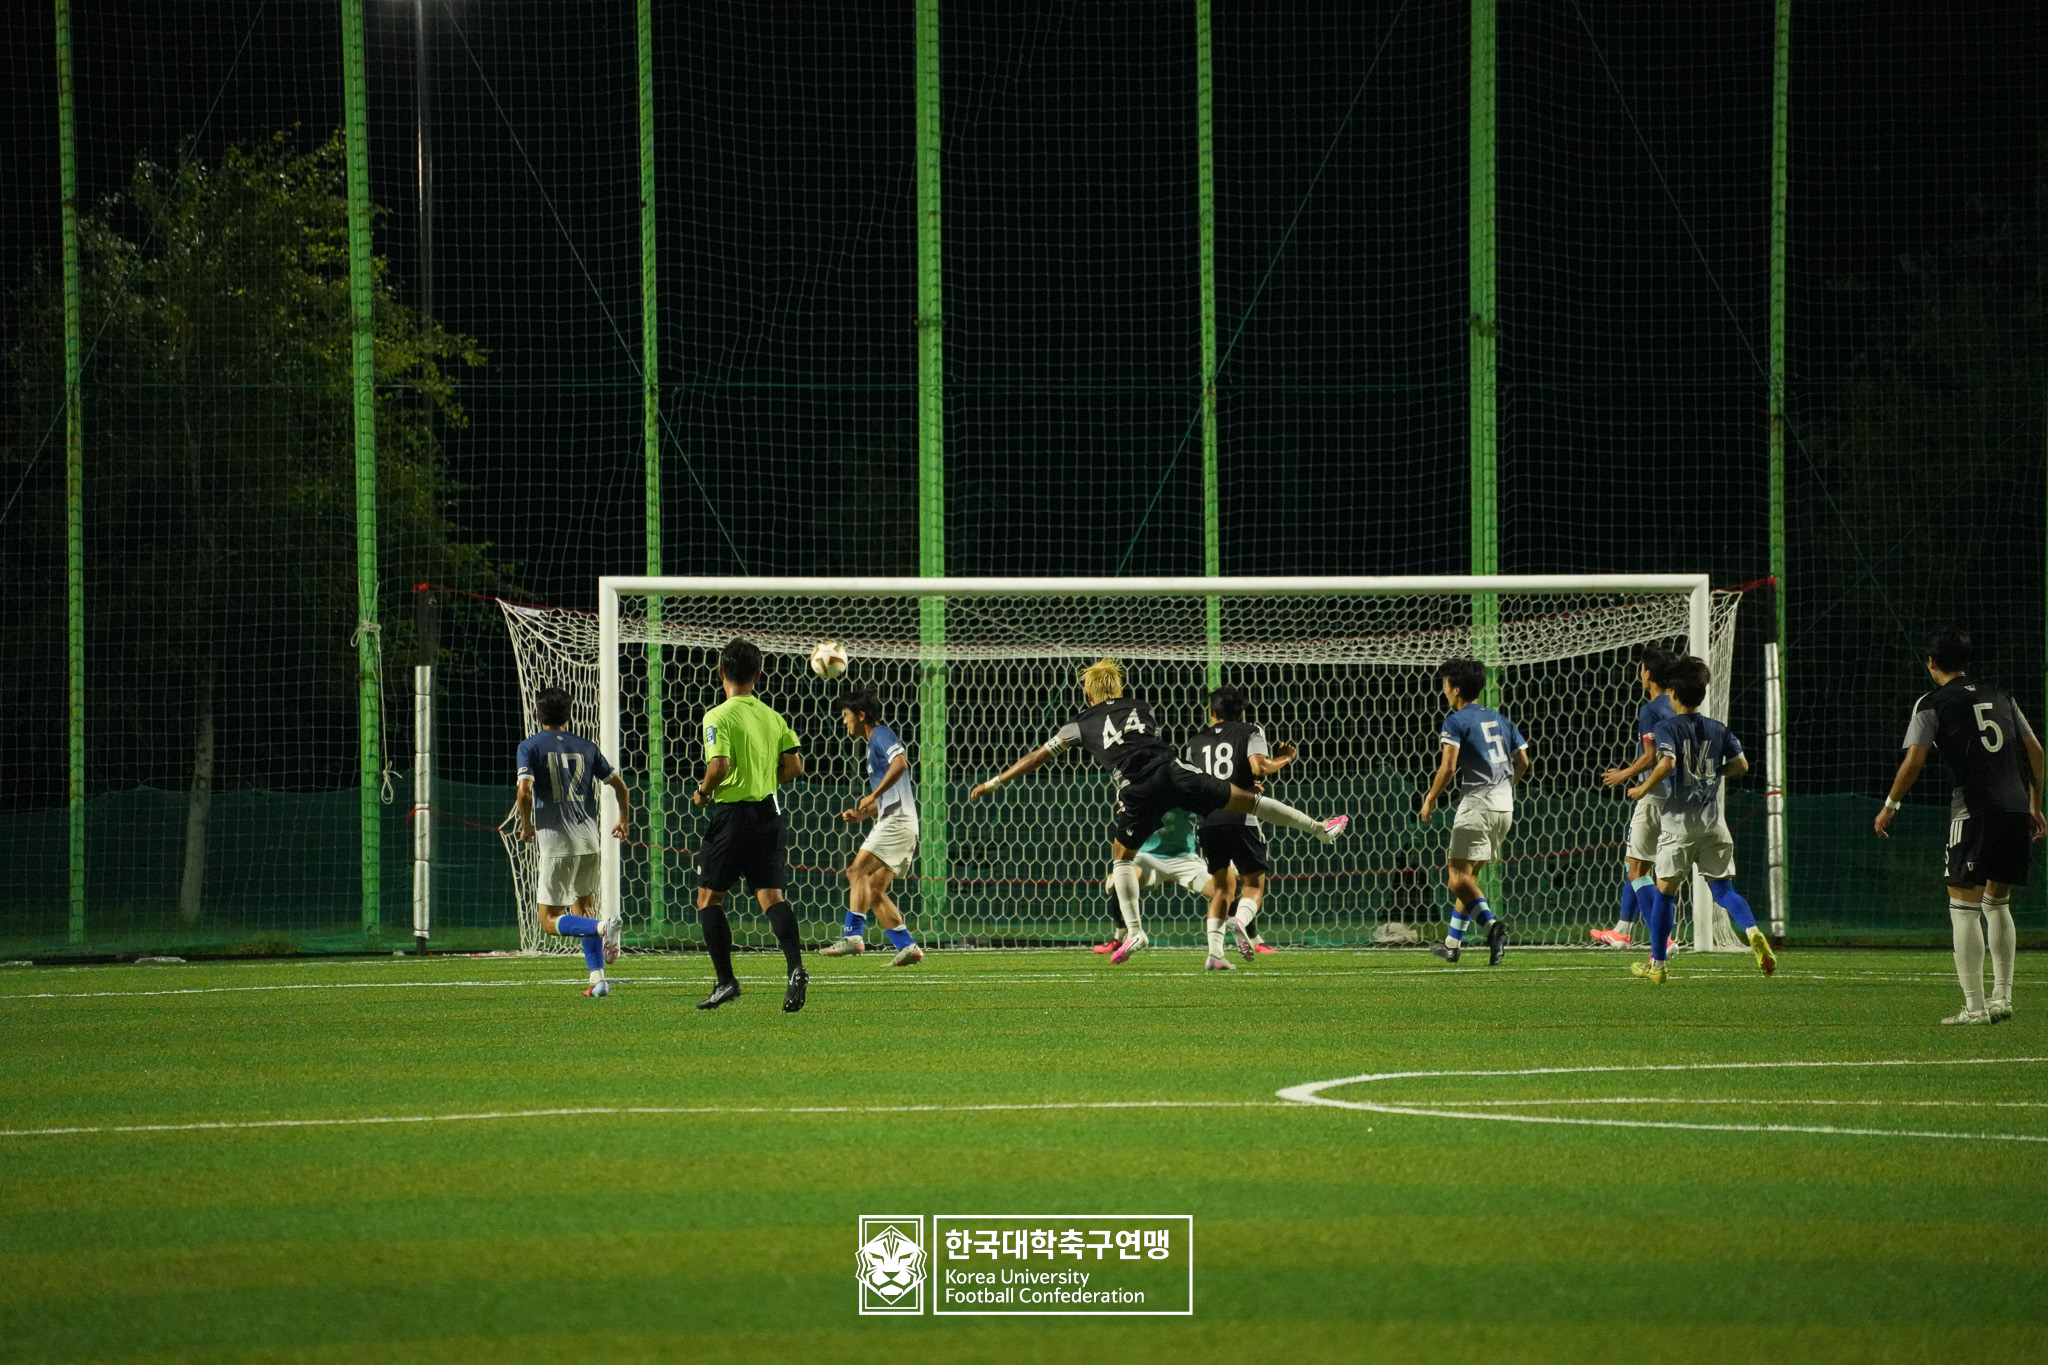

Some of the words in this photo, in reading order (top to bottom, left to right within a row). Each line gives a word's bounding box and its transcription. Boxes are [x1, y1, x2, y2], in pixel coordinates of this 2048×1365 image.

[1102, 708, 1146, 750] 44
[1480, 720, 1508, 764] 5
[1973, 703, 2004, 753] 5
[547, 752, 585, 803] 12
[1202, 742, 1234, 780] 18
[1682, 739, 1716, 786] 14
